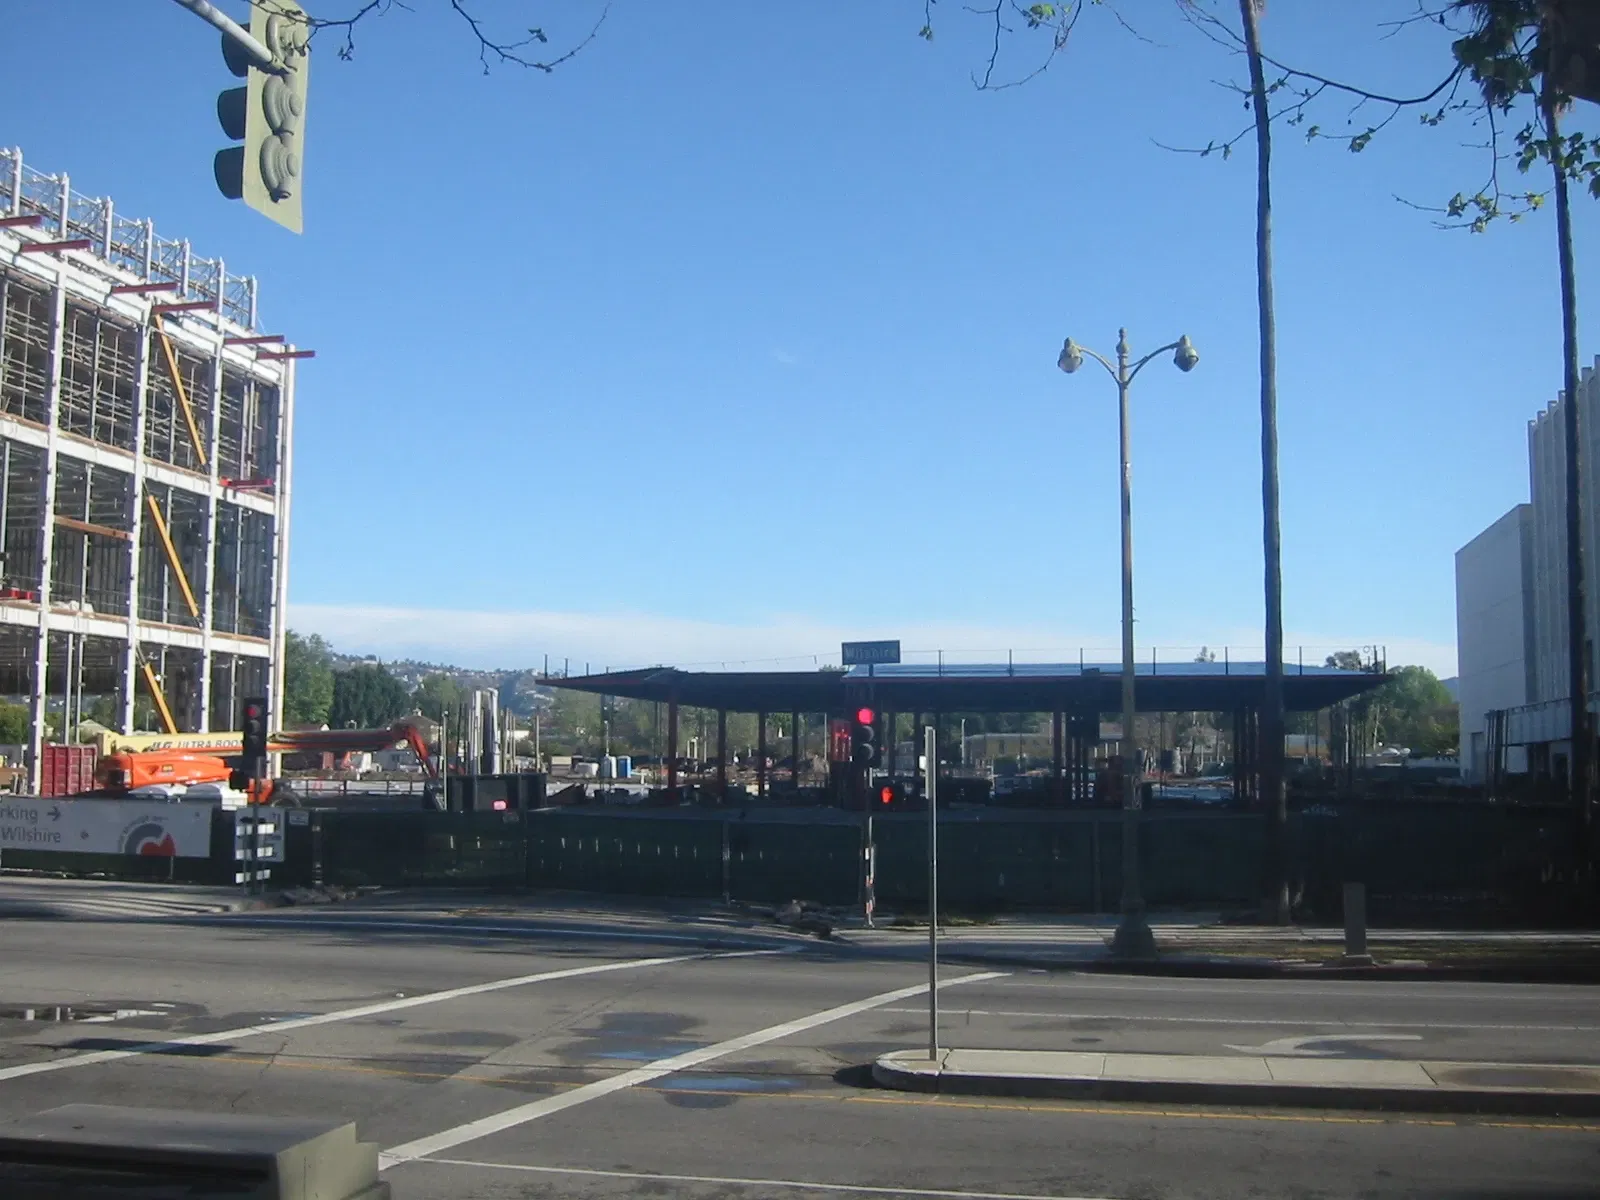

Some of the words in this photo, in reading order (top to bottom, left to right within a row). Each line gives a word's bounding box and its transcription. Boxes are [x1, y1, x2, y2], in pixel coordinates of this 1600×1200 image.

[845, 647, 897, 660] Wilshire
[178, 740, 212, 749] ULTRA
[1, 825, 61, 843] Wilshire
